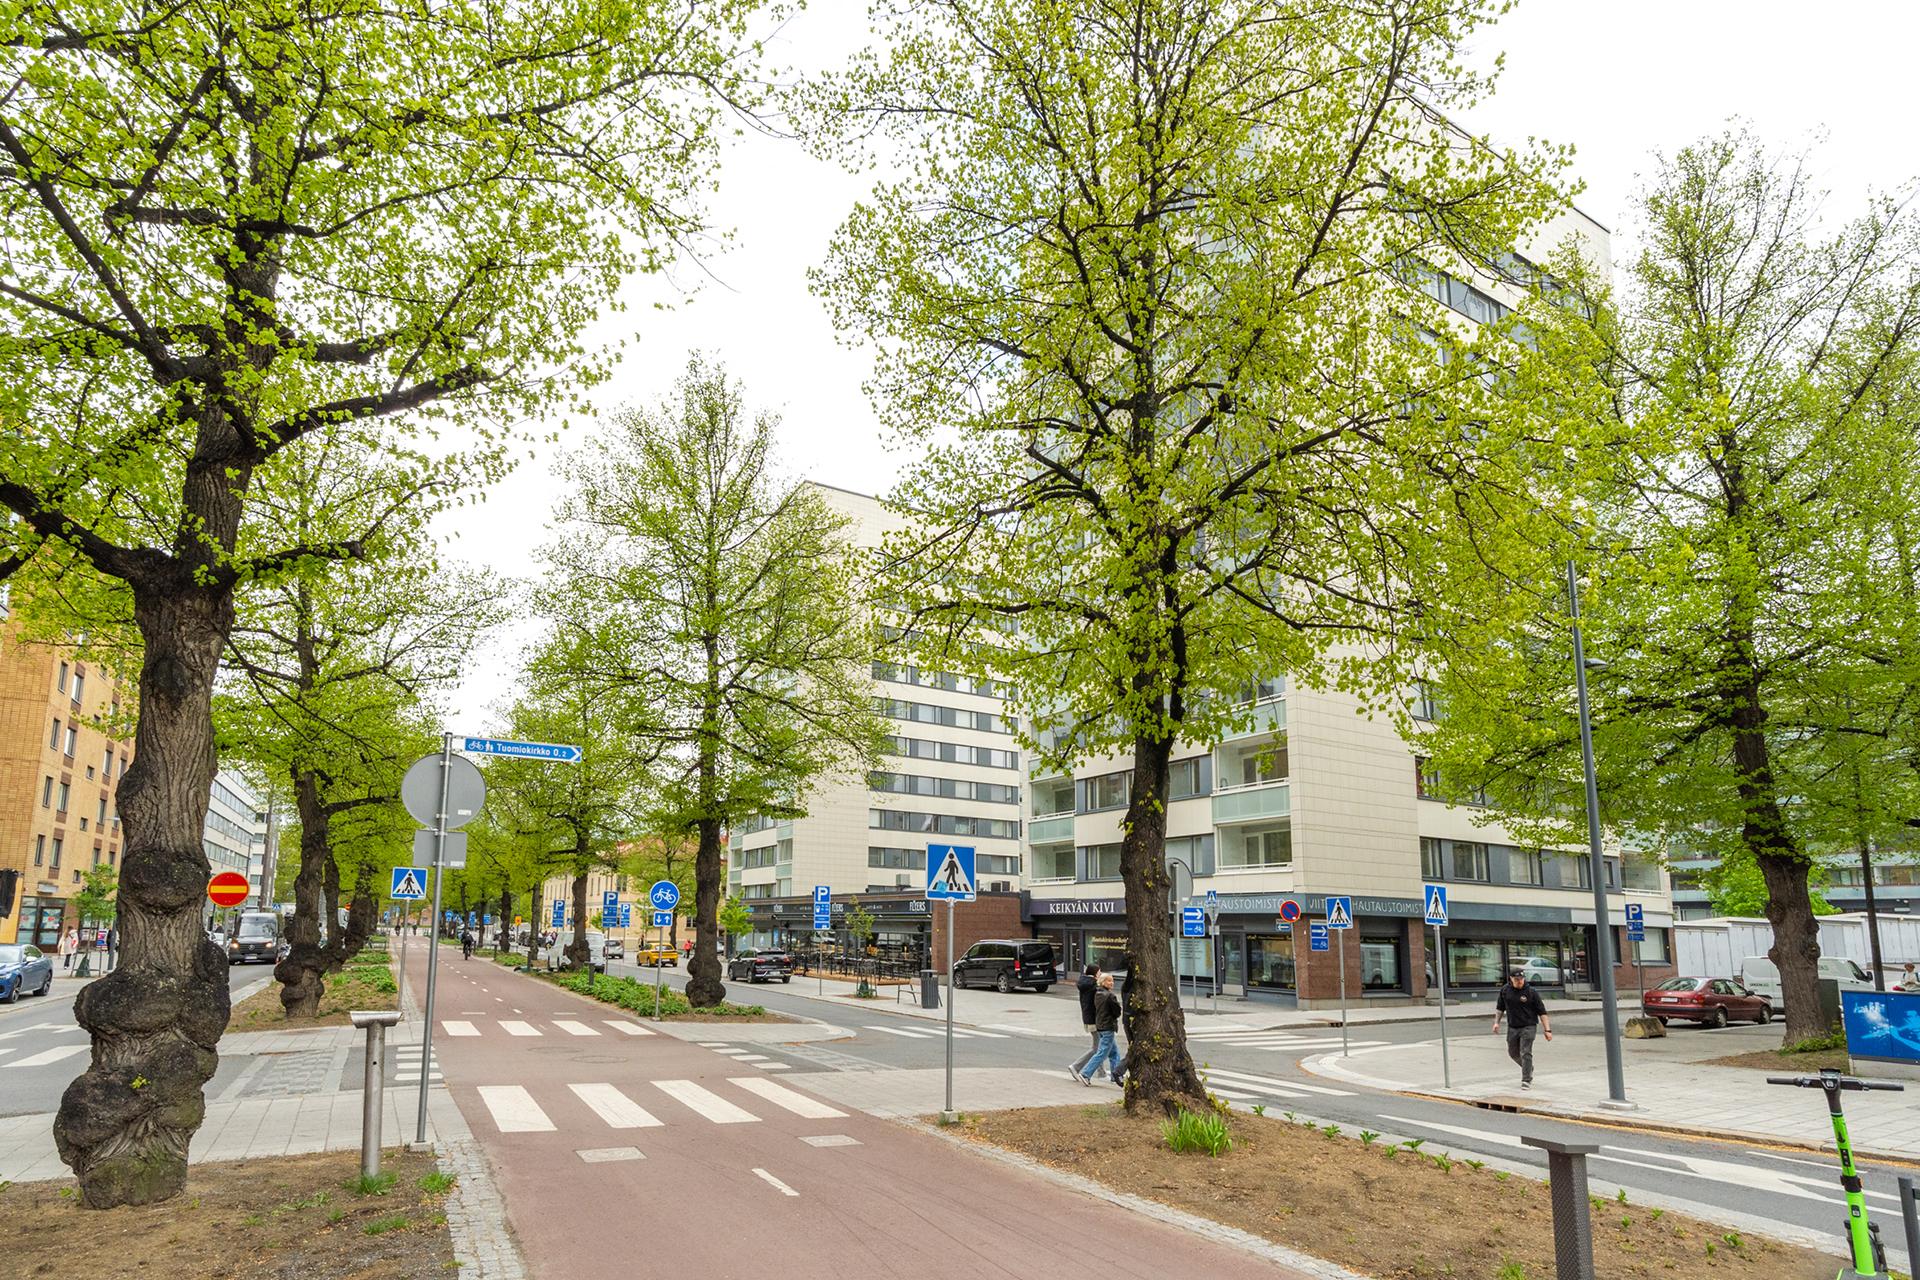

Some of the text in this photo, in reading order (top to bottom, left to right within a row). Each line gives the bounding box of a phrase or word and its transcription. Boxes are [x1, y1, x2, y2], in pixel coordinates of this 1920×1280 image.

[496, 743, 550, 756] Tuomiokirkko
[607, 893, 616, 905] P
[818, 887, 828, 901] P
[556, 901, 564, 910] P
[622, 904, 630, 913] P
[1049, 900, 1115, 914] KEIKYÄN KIVI
[1628, 905, 1640, 920] P
